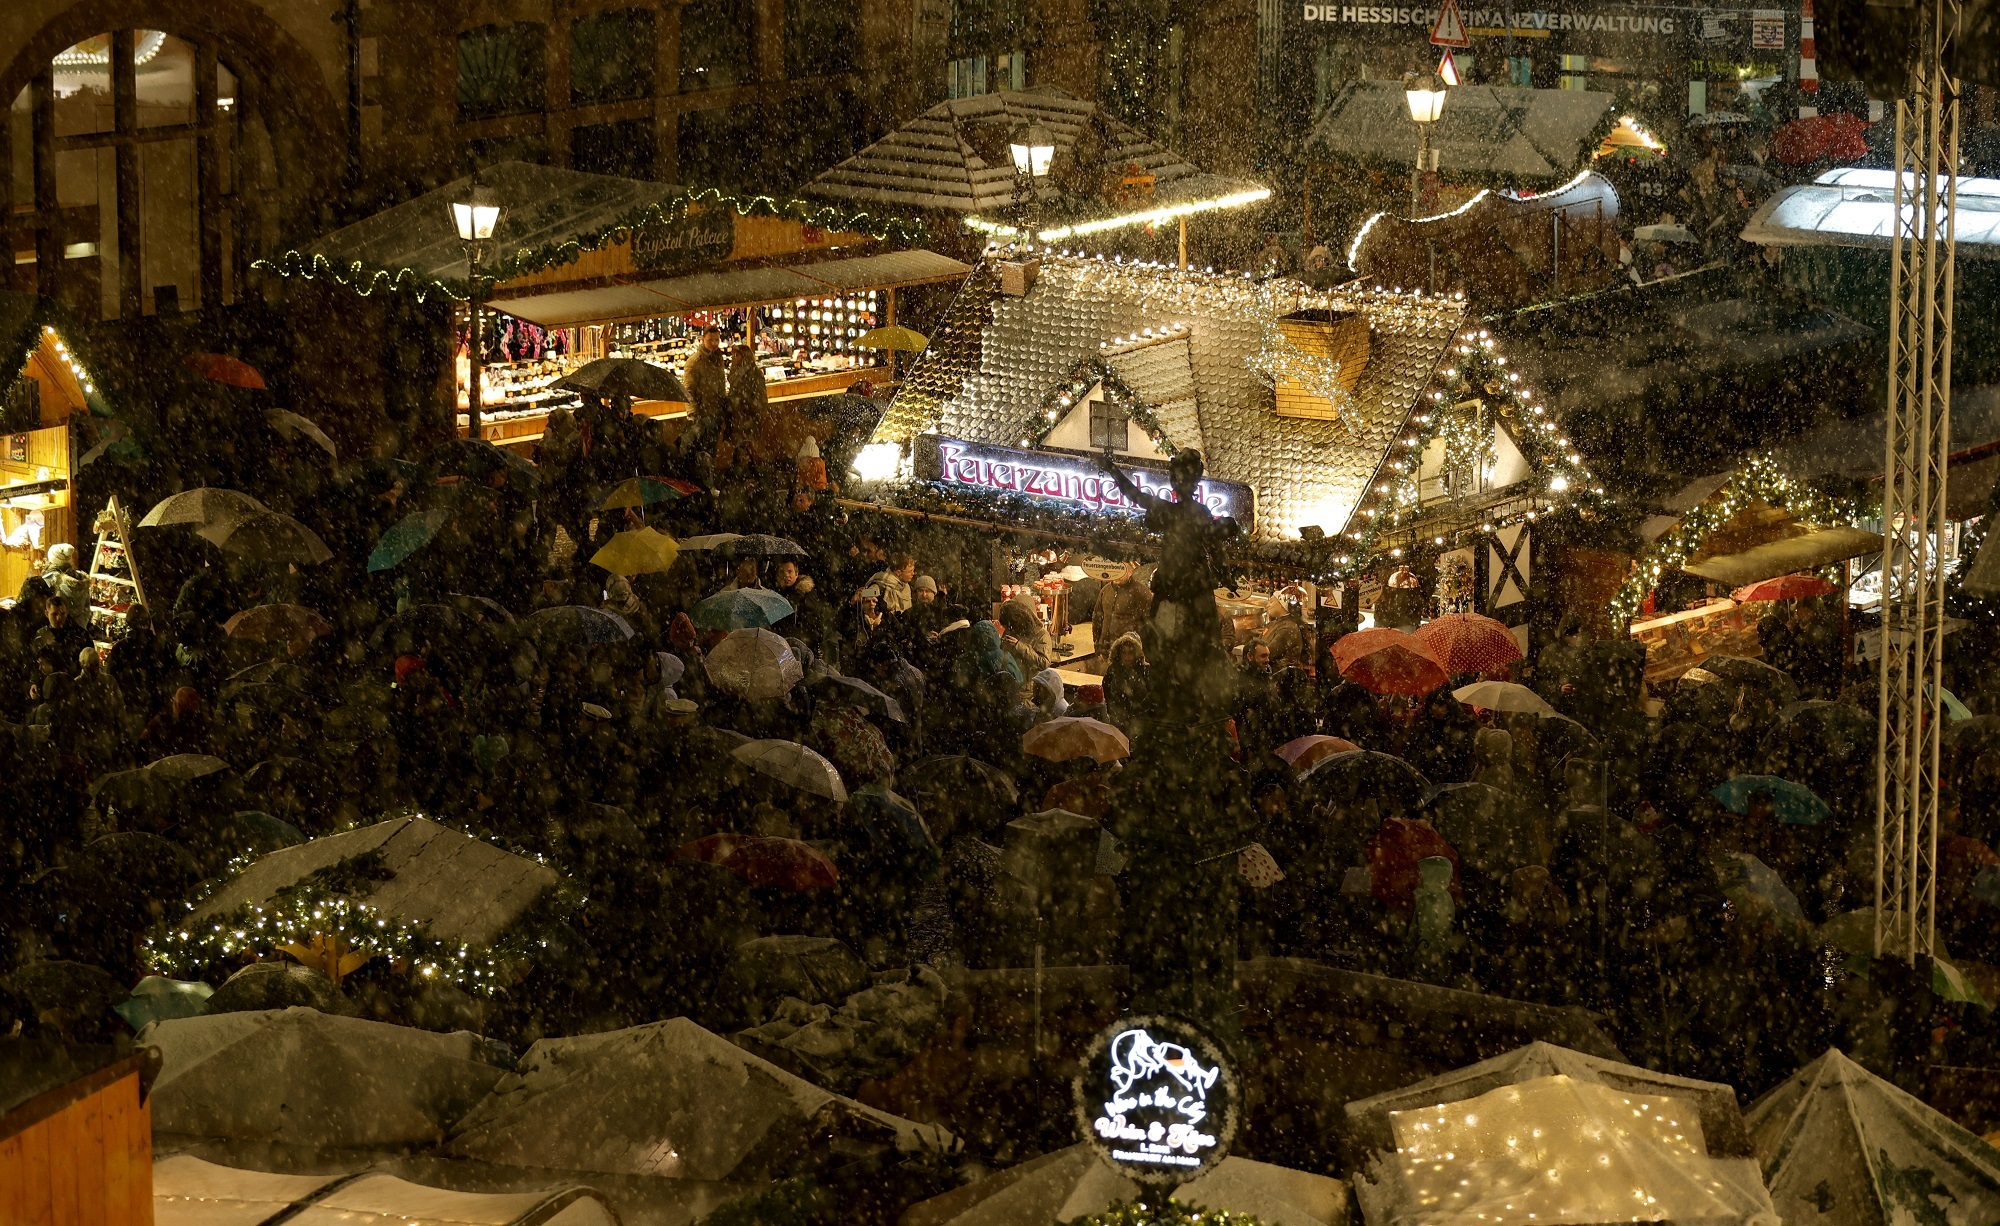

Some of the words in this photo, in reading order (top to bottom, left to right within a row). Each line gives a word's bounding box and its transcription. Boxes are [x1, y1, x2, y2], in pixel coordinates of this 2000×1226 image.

[1303, 4, 1337, 22] DIE
[1342, 5, 1438, 25] HESSISCH
[636, 230, 684, 260] Crystal
[688, 226, 729, 250] Palace
